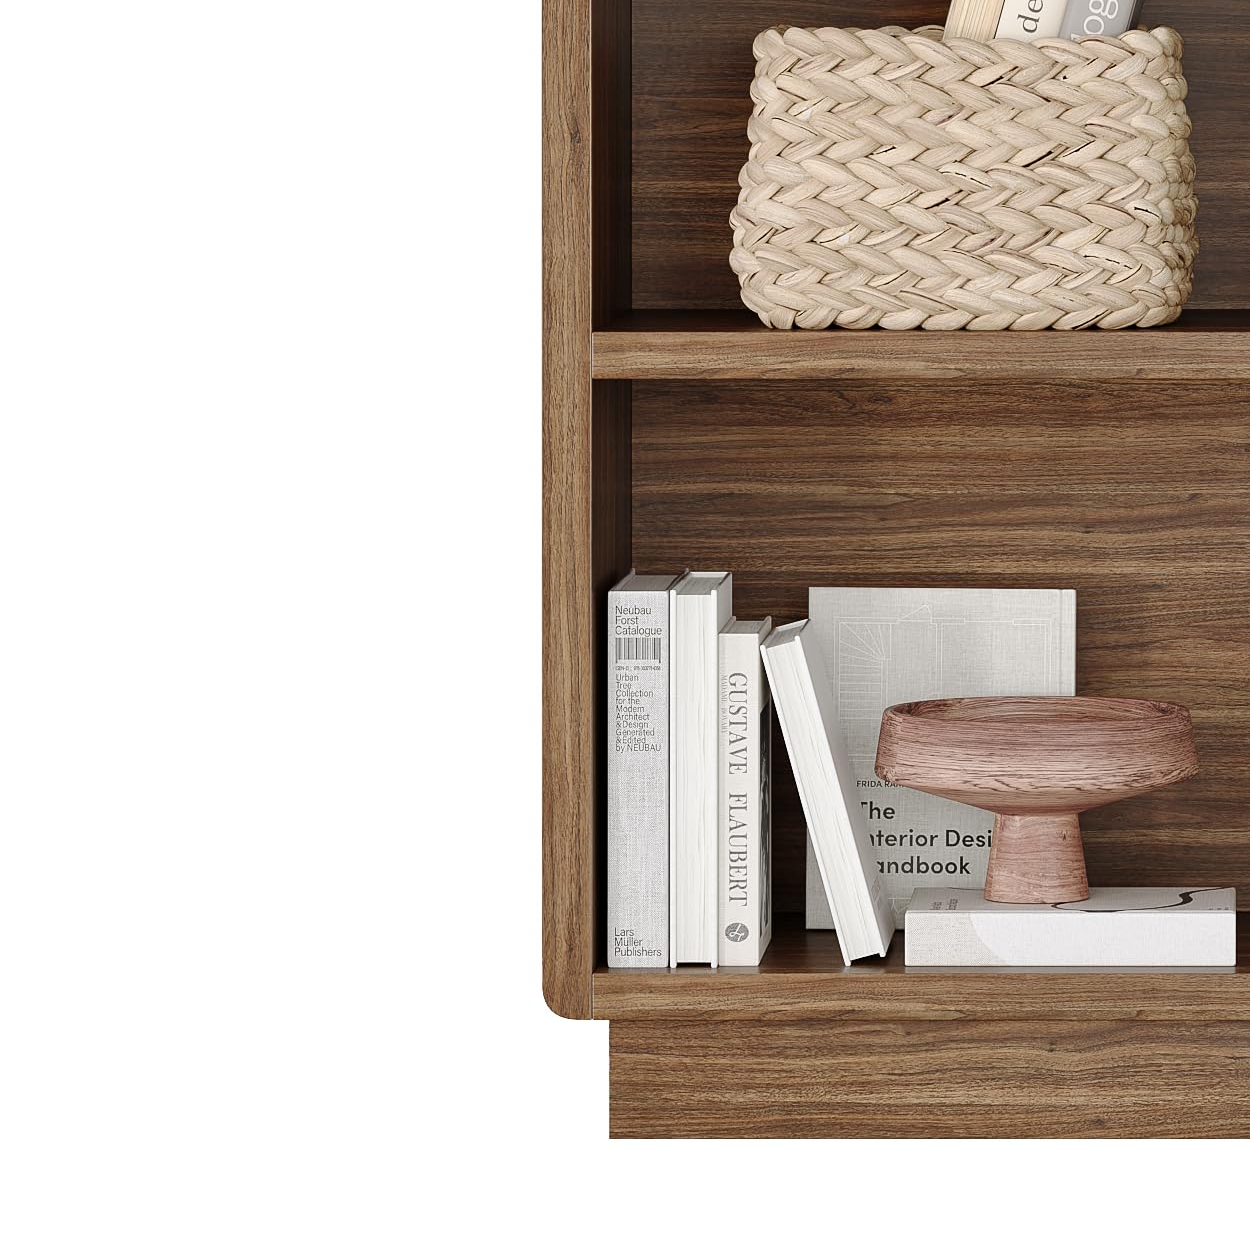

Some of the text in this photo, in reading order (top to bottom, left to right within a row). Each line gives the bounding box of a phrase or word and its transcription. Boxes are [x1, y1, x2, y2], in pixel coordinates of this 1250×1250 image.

[615, 605, 652, 615] Neubau
[615, 615, 639, 625] Forst
[615, 625, 662, 637] Catalogue
[615, 673, 639, 681] Urban
[615, 689, 654, 697] Collection
[615, 728, 655, 736] Generated
[615, 744, 662, 753] by NEUBAU
[856, 780, 883, 788] FRIDA
[728, 672, 748, 907] GUSTAVE FLAUBERT
[945, 829, 992, 848] Desi
[614, 927, 635, 936] Lars
[614, 946, 662, 957] Publishers
